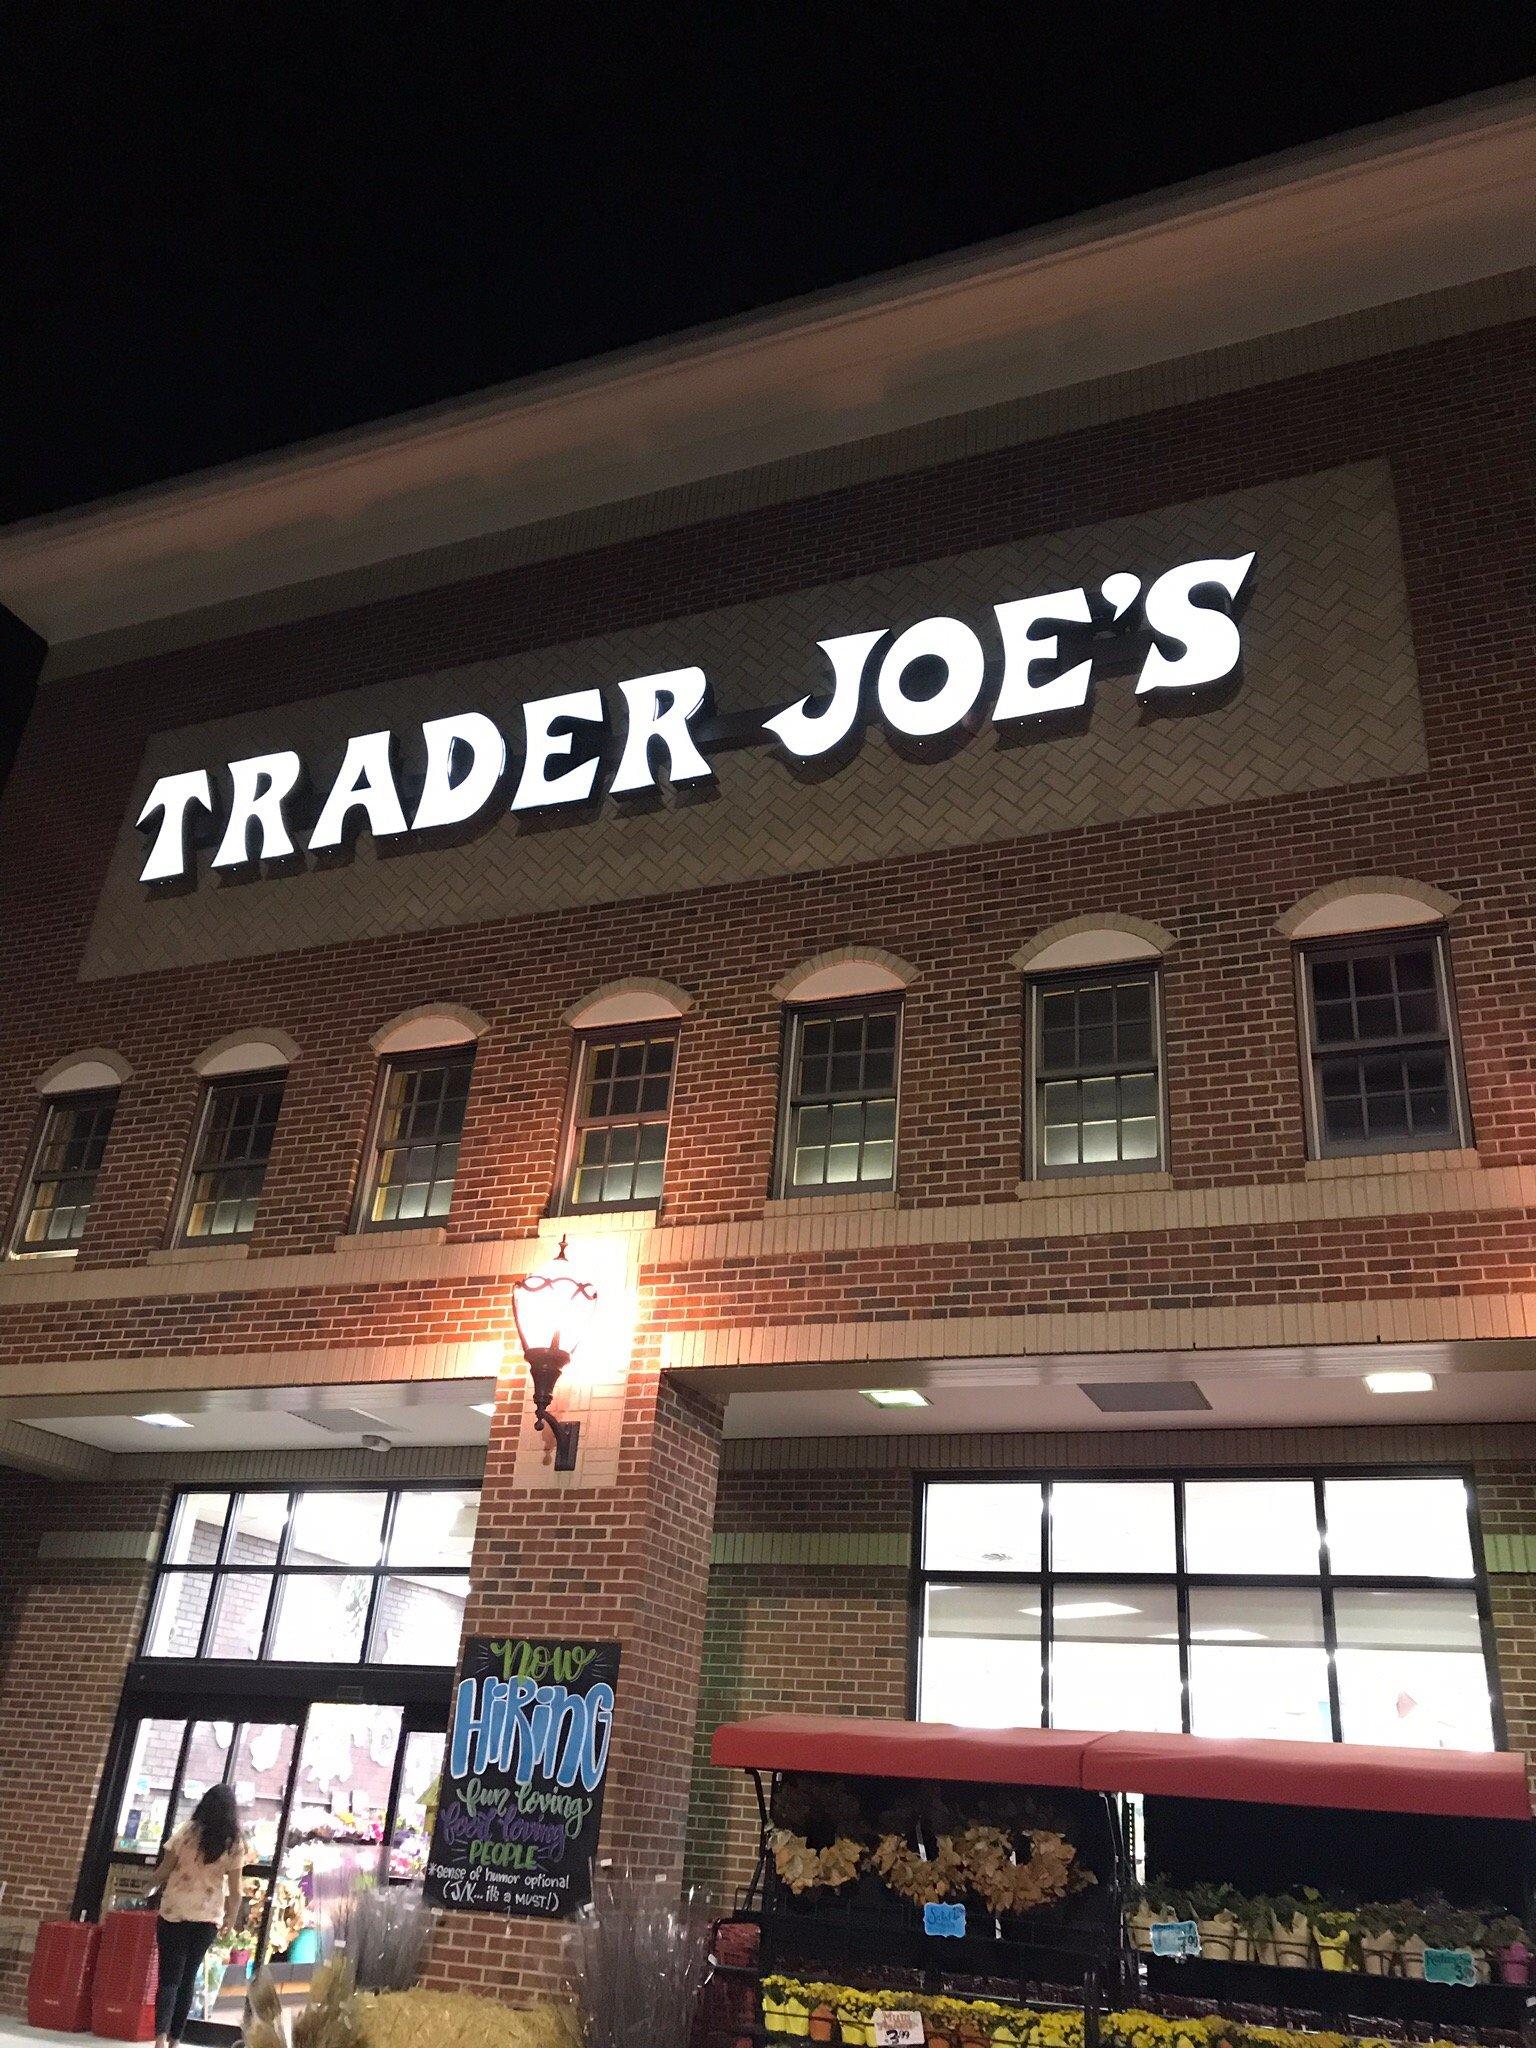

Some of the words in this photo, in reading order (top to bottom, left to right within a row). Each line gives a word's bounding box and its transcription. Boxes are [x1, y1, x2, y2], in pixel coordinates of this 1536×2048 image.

[136, 666, 712, 882] TRADER
[761, 551, 1256, 756] JOE'S
[456, 1778, 510, 1818] fun
[514, 1782, 593, 1839] loving
[469, 1839, 539, 1869] PEOPLE
[470, 1865, 482, 1881] of
[486, 1867, 521, 1884] humor
[524, 1875, 570, 1890] optional
[503, 1892, 511, 1902] a
[515, 1892, 560, 1912] MUST!)
